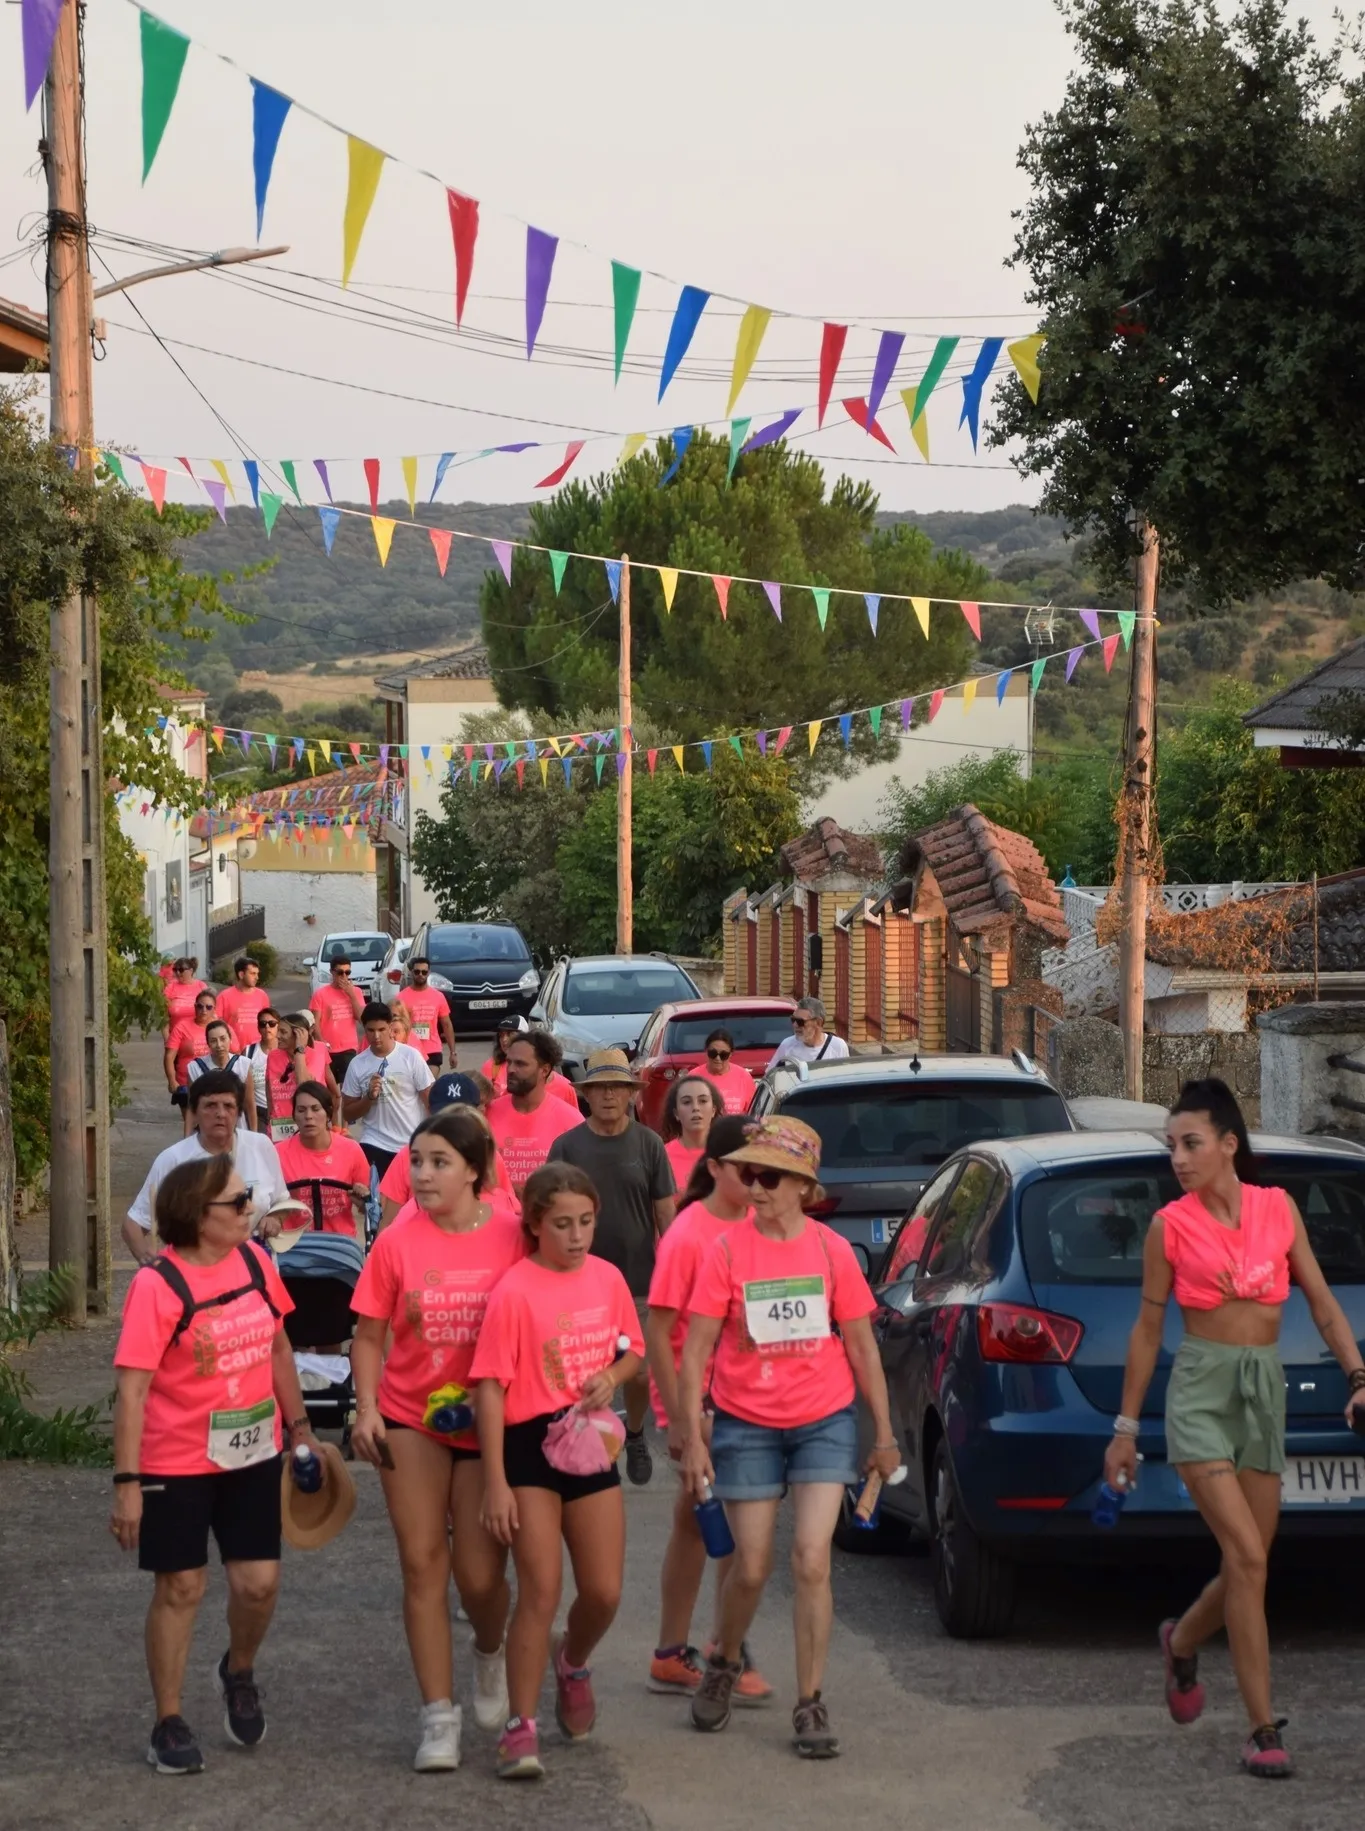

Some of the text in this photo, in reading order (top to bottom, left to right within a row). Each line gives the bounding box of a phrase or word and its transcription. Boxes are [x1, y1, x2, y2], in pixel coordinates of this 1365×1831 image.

[448, 1083, 461, 1097] NY
[280, 1126, 295, 1134] 195
[503, 1149, 515, 1157] En
[423, 1289, 445, 1305] En
[768, 1300, 807, 1321] 450
[211, 1319, 234, 1335] En
[560, 1334, 580, 1349] En
[229, 1426, 261, 1450] 432
[1297, 1461, 1360, 1490] HVH
